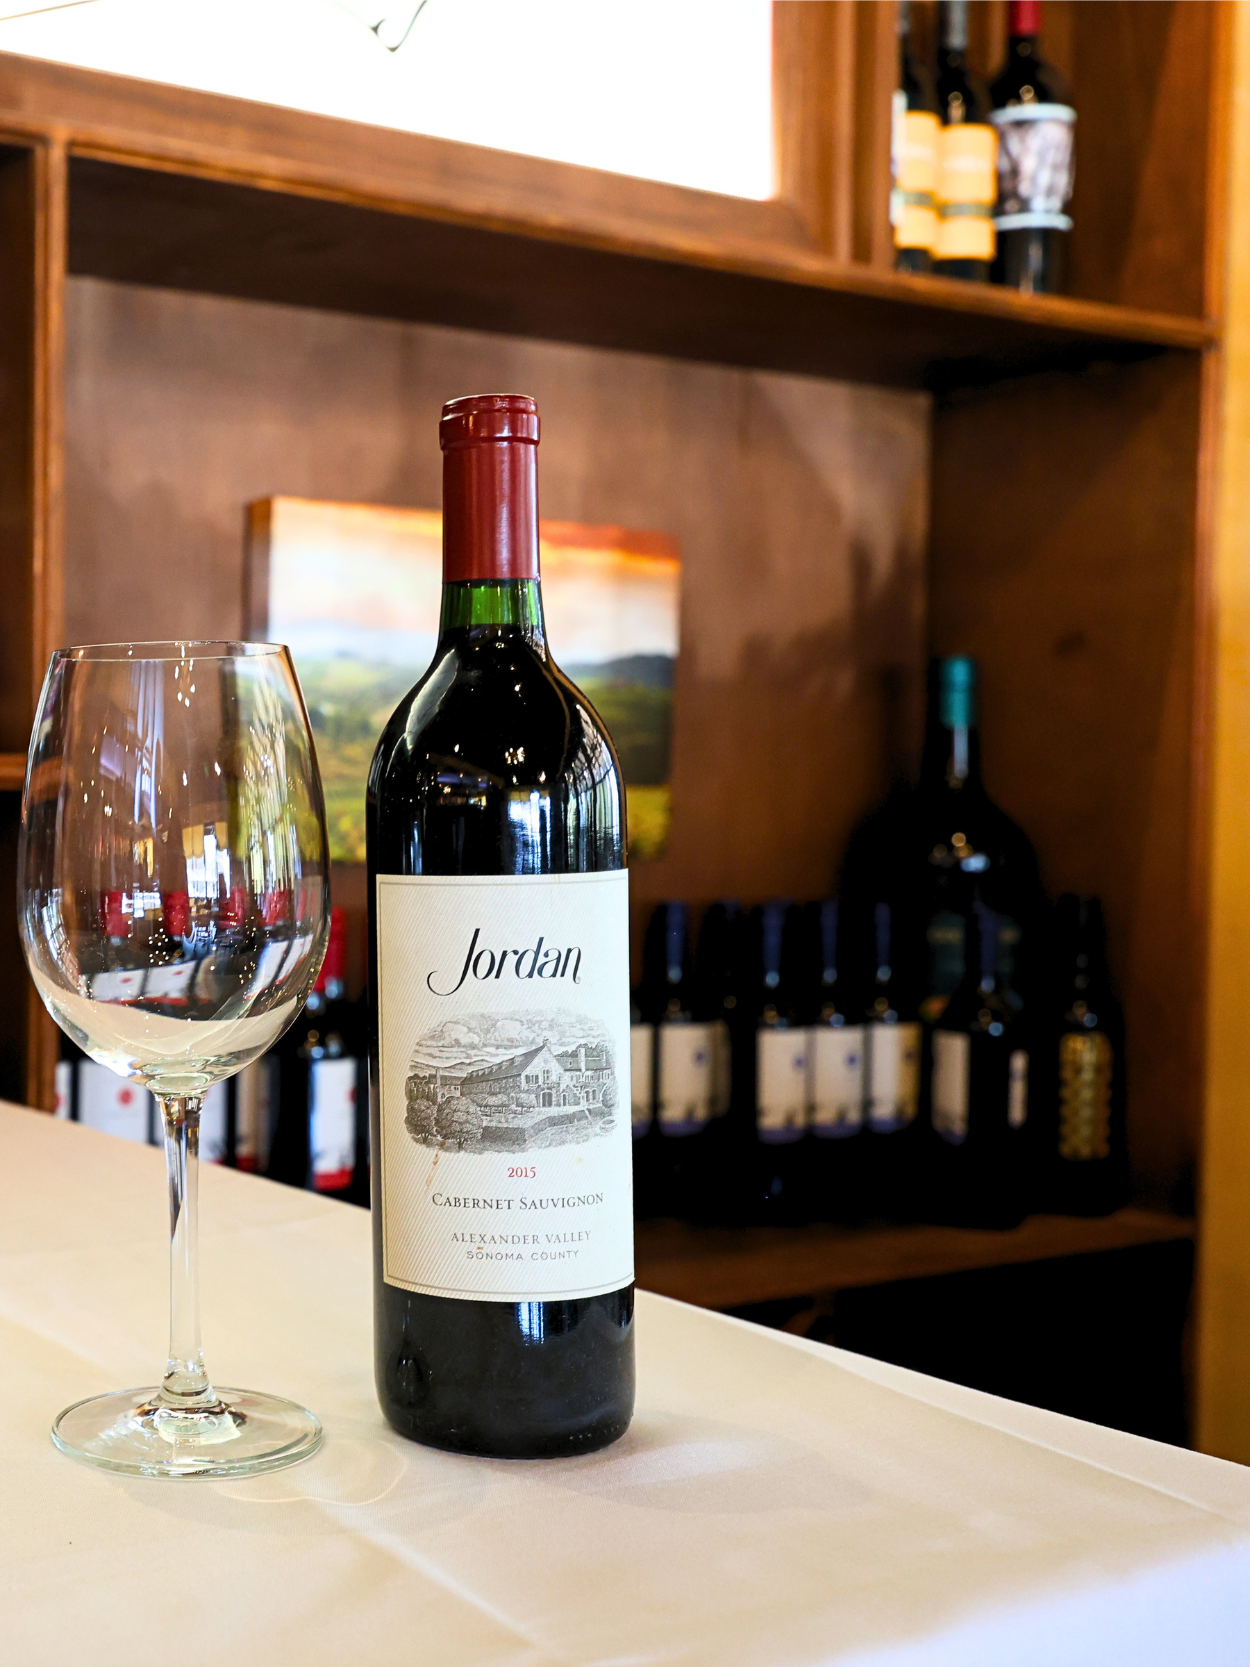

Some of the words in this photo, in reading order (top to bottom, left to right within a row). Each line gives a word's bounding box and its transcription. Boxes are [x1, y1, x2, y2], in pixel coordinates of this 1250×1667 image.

[426, 927, 582, 997] Jordan
[507, 1166, 537, 1179] 2015
[431, 1192, 515, 1210] CABERNET
[519, 1192, 604, 1210] SAUVIGNON
[450, 1231, 541, 1246] ALEXANDER
[545, 1229, 591, 1244] VALLEY
[466, 1250, 525, 1261] SONOMA
[530, 1249, 579, 1261] COUNTY
